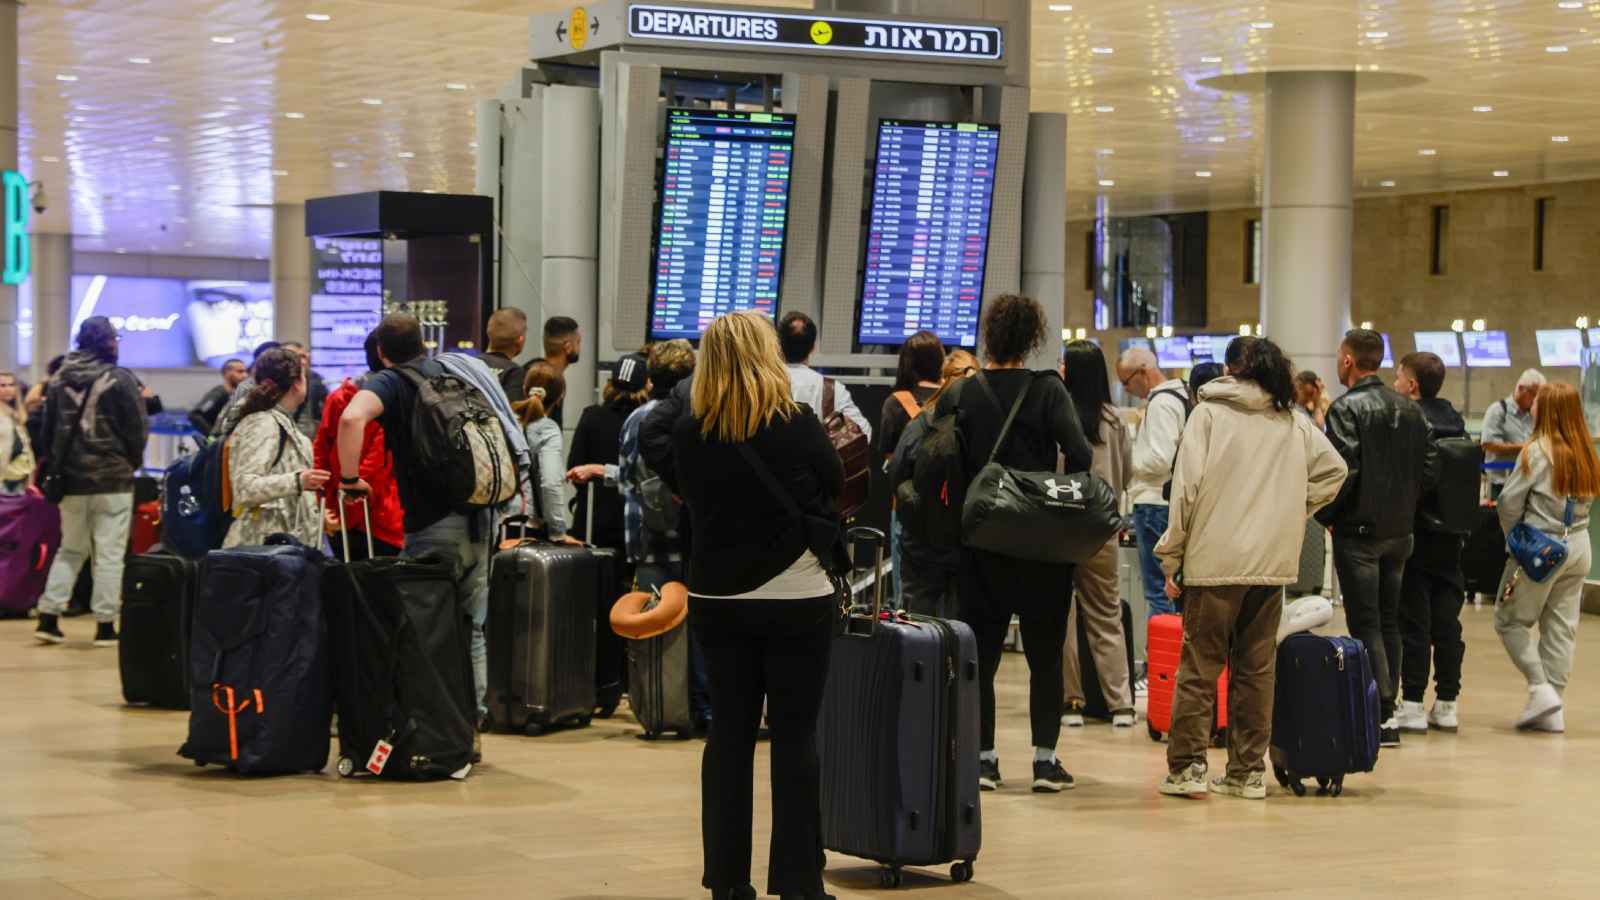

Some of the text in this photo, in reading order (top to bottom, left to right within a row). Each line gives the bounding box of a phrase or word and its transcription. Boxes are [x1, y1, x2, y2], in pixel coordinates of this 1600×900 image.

[638, 11, 778, 40] DEPARTURES
[864, 26, 989, 53] המראות
[2, 170, 31, 286] B
